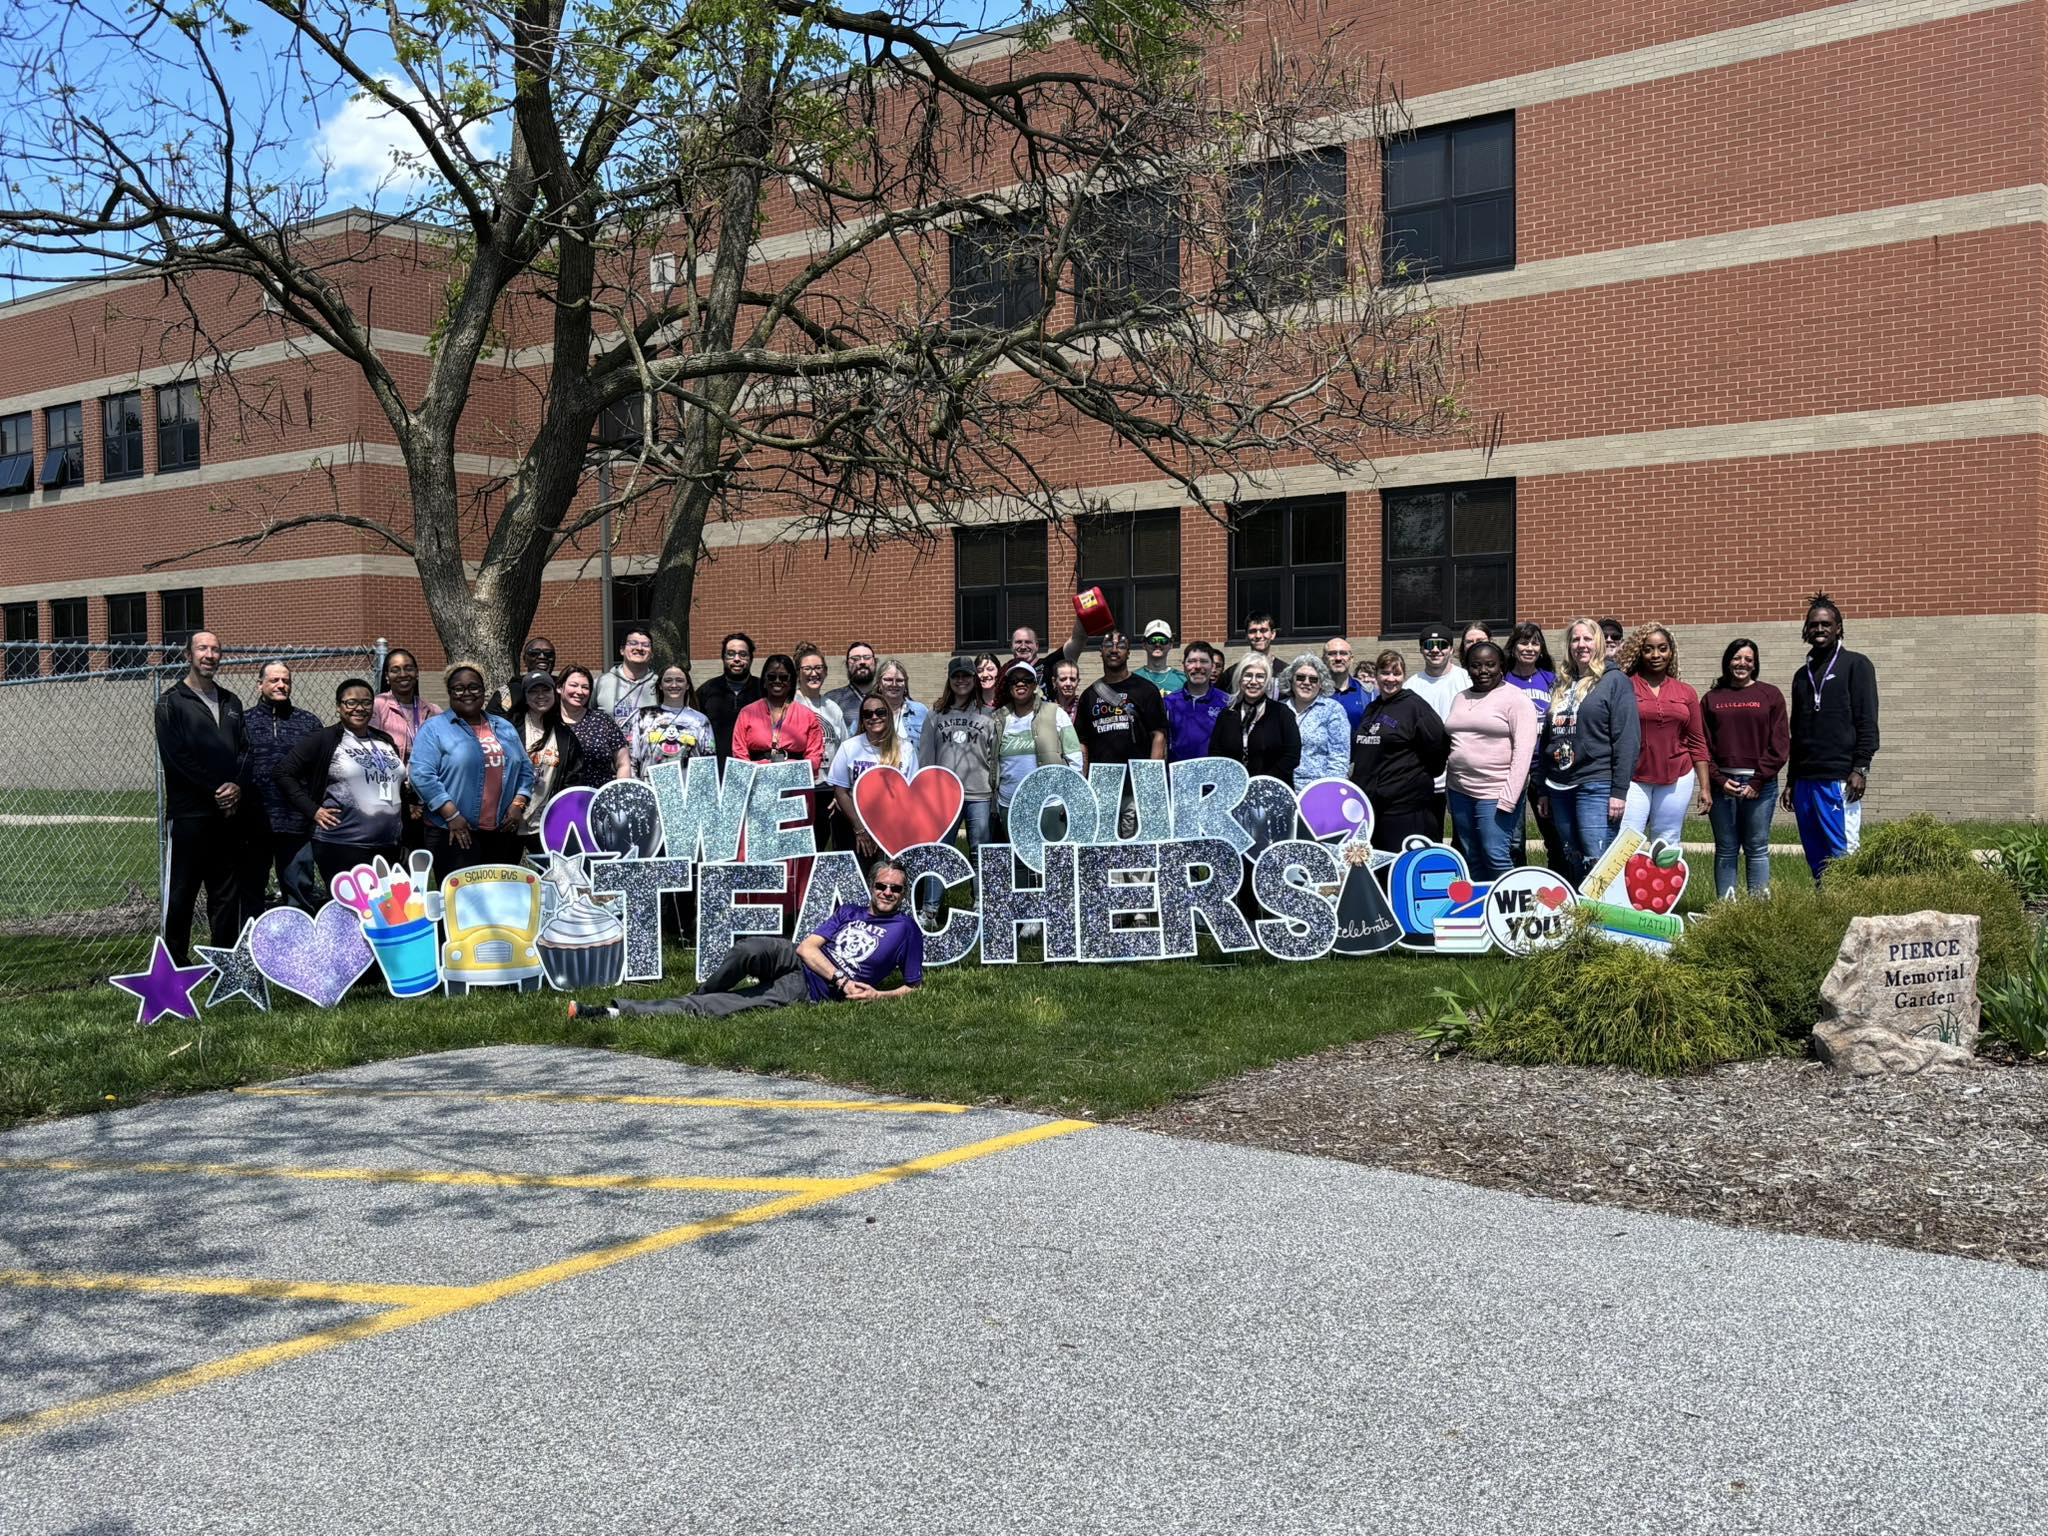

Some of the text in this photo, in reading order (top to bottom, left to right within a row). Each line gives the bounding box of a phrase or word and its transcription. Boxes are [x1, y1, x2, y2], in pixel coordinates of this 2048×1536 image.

[937, 718, 984, 734] BASEBALL
[1096, 722, 1130, 734] EVERYTHING
[649, 756, 1256, 875] WE OUR
[464, 870, 518, 882] SCHOOL BUS
[591, 836, 1342, 984] TEACHERS
[1494, 889, 1533, 914] WE
[848, 920, 887, 938] PIRATE
[1505, 916, 1560, 941] YOU
[1638, 916, 1666, 933] MATH
[1889, 939, 1960, 962] PIERCE
[1884, 963, 1964, 988] Memorial
[1894, 991, 1955, 1009] Garden
